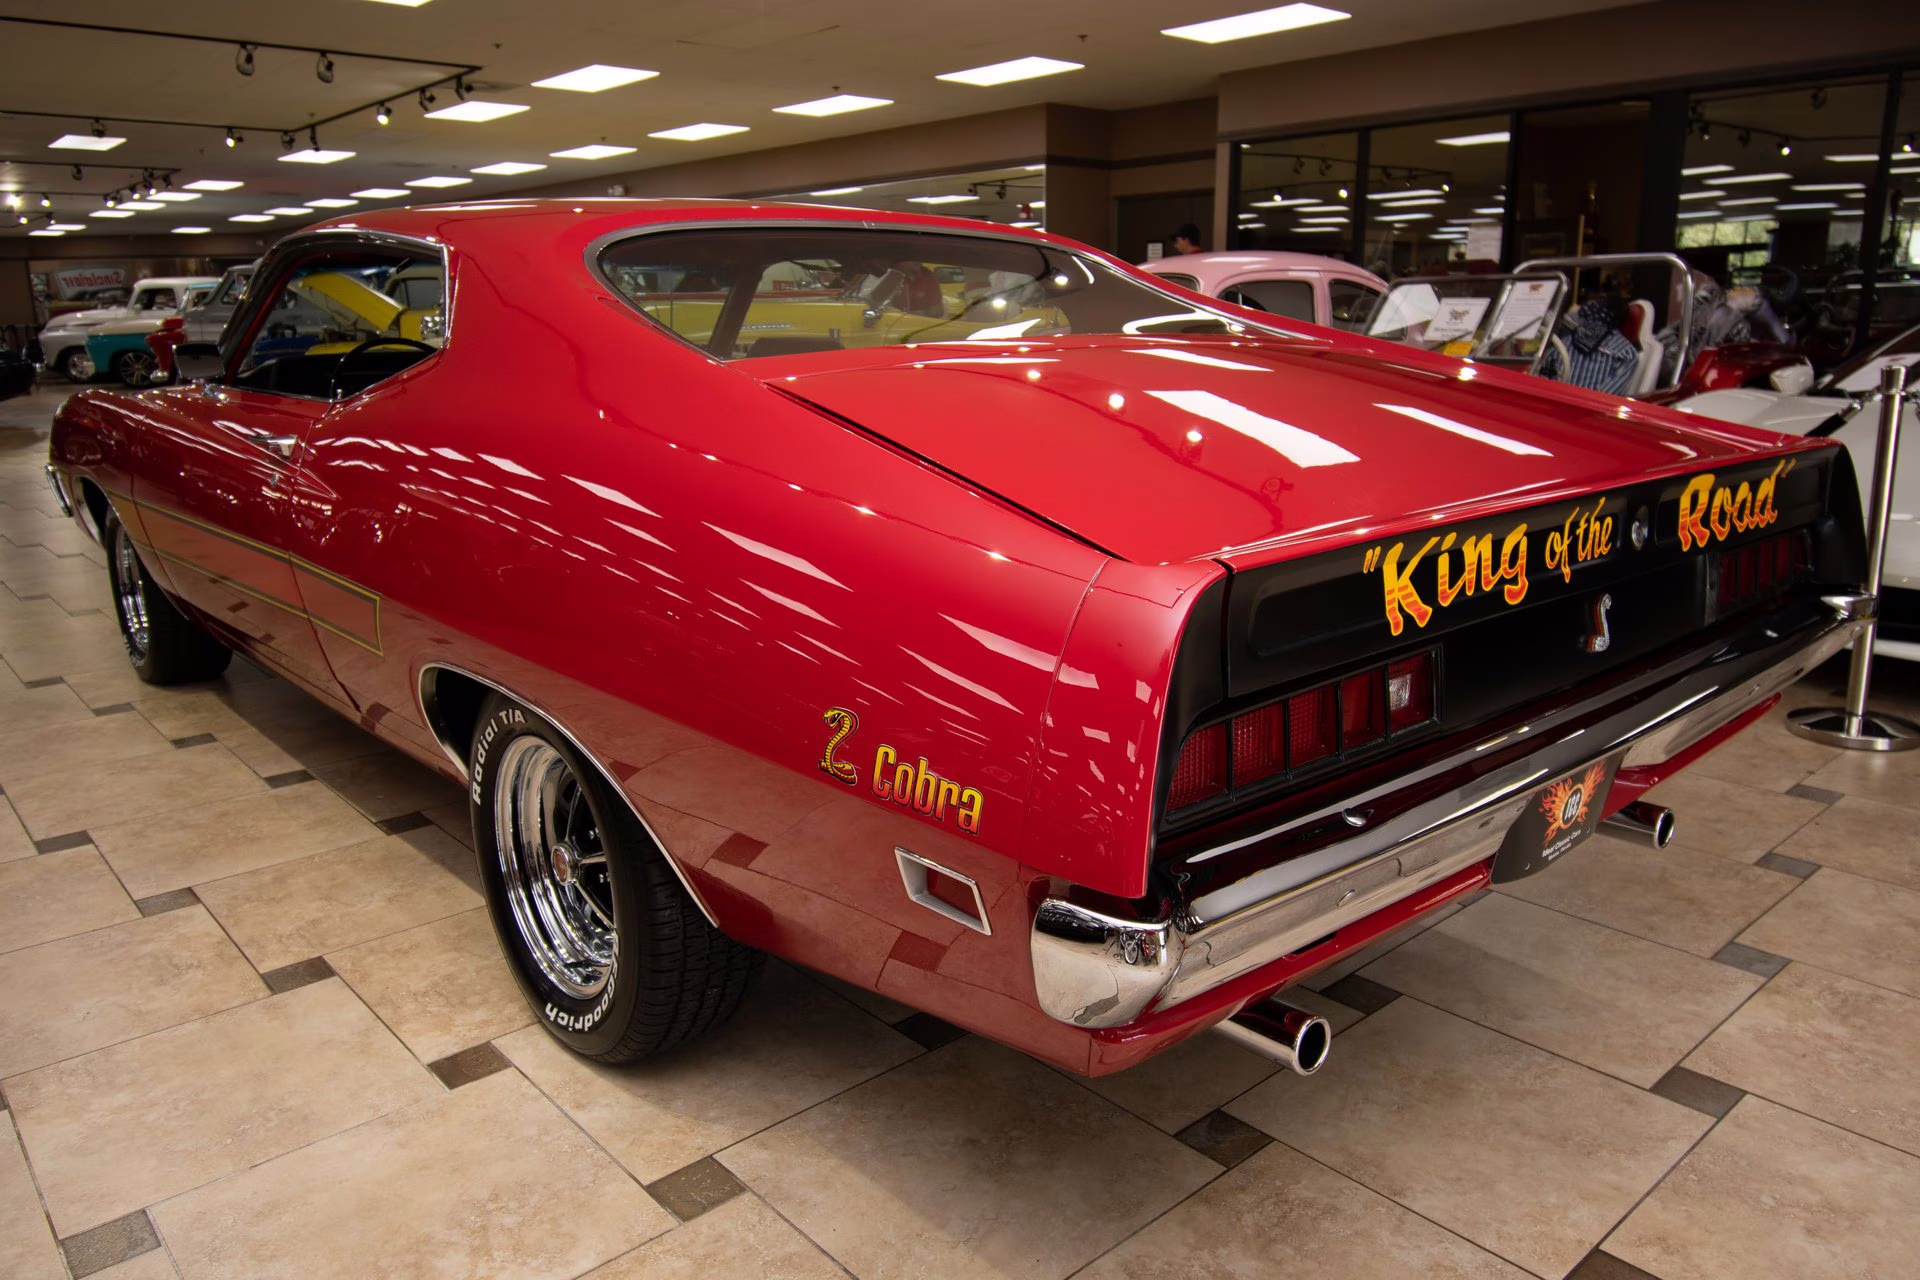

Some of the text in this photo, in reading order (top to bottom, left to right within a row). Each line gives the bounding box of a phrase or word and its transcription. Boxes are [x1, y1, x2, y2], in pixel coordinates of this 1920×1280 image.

[1363, 458, 1797, 637] "King of the Road"
[472, 709, 526, 805] Radial T/A
[872, 744, 984, 836] Cobra
